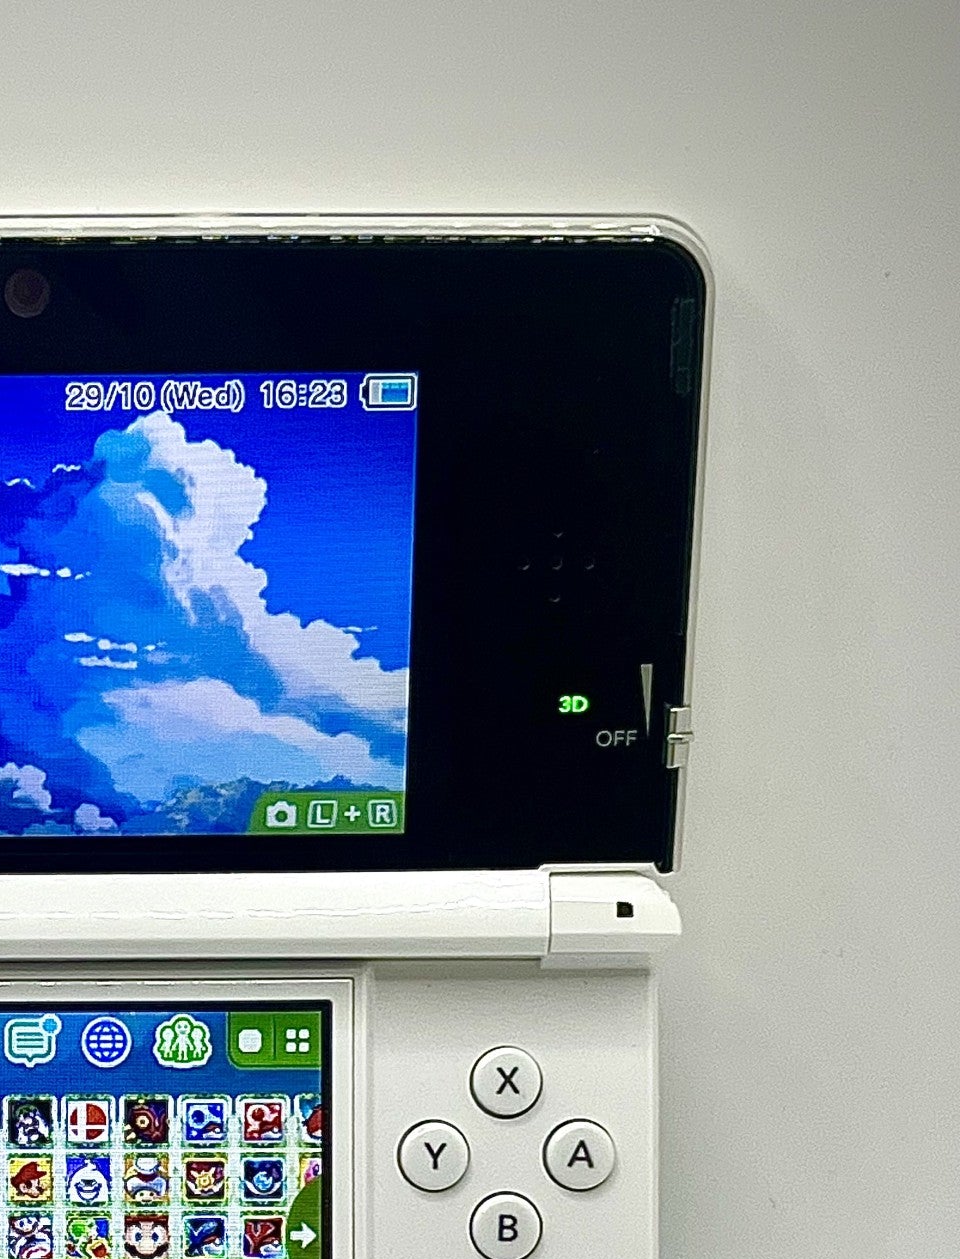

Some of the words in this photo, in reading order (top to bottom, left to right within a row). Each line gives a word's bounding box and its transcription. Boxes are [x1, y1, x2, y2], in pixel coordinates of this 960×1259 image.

[65, 381, 156, 411] 29/10
[160, 380, 245, 412] (Wed)
[259, 379, 347, 409] 16:23
[558, 695, 589, 713] 3D
[595, 729, 638, 747] OFF
[315, 803, 332, 824] L
[375, 803, 391, 824] R
[495, 1065, 521, 1095] X
[423, 1141, 448, 1171] Y
[566, 1138, 595, 1169] A
[497, 1213, 519, 1243] B
